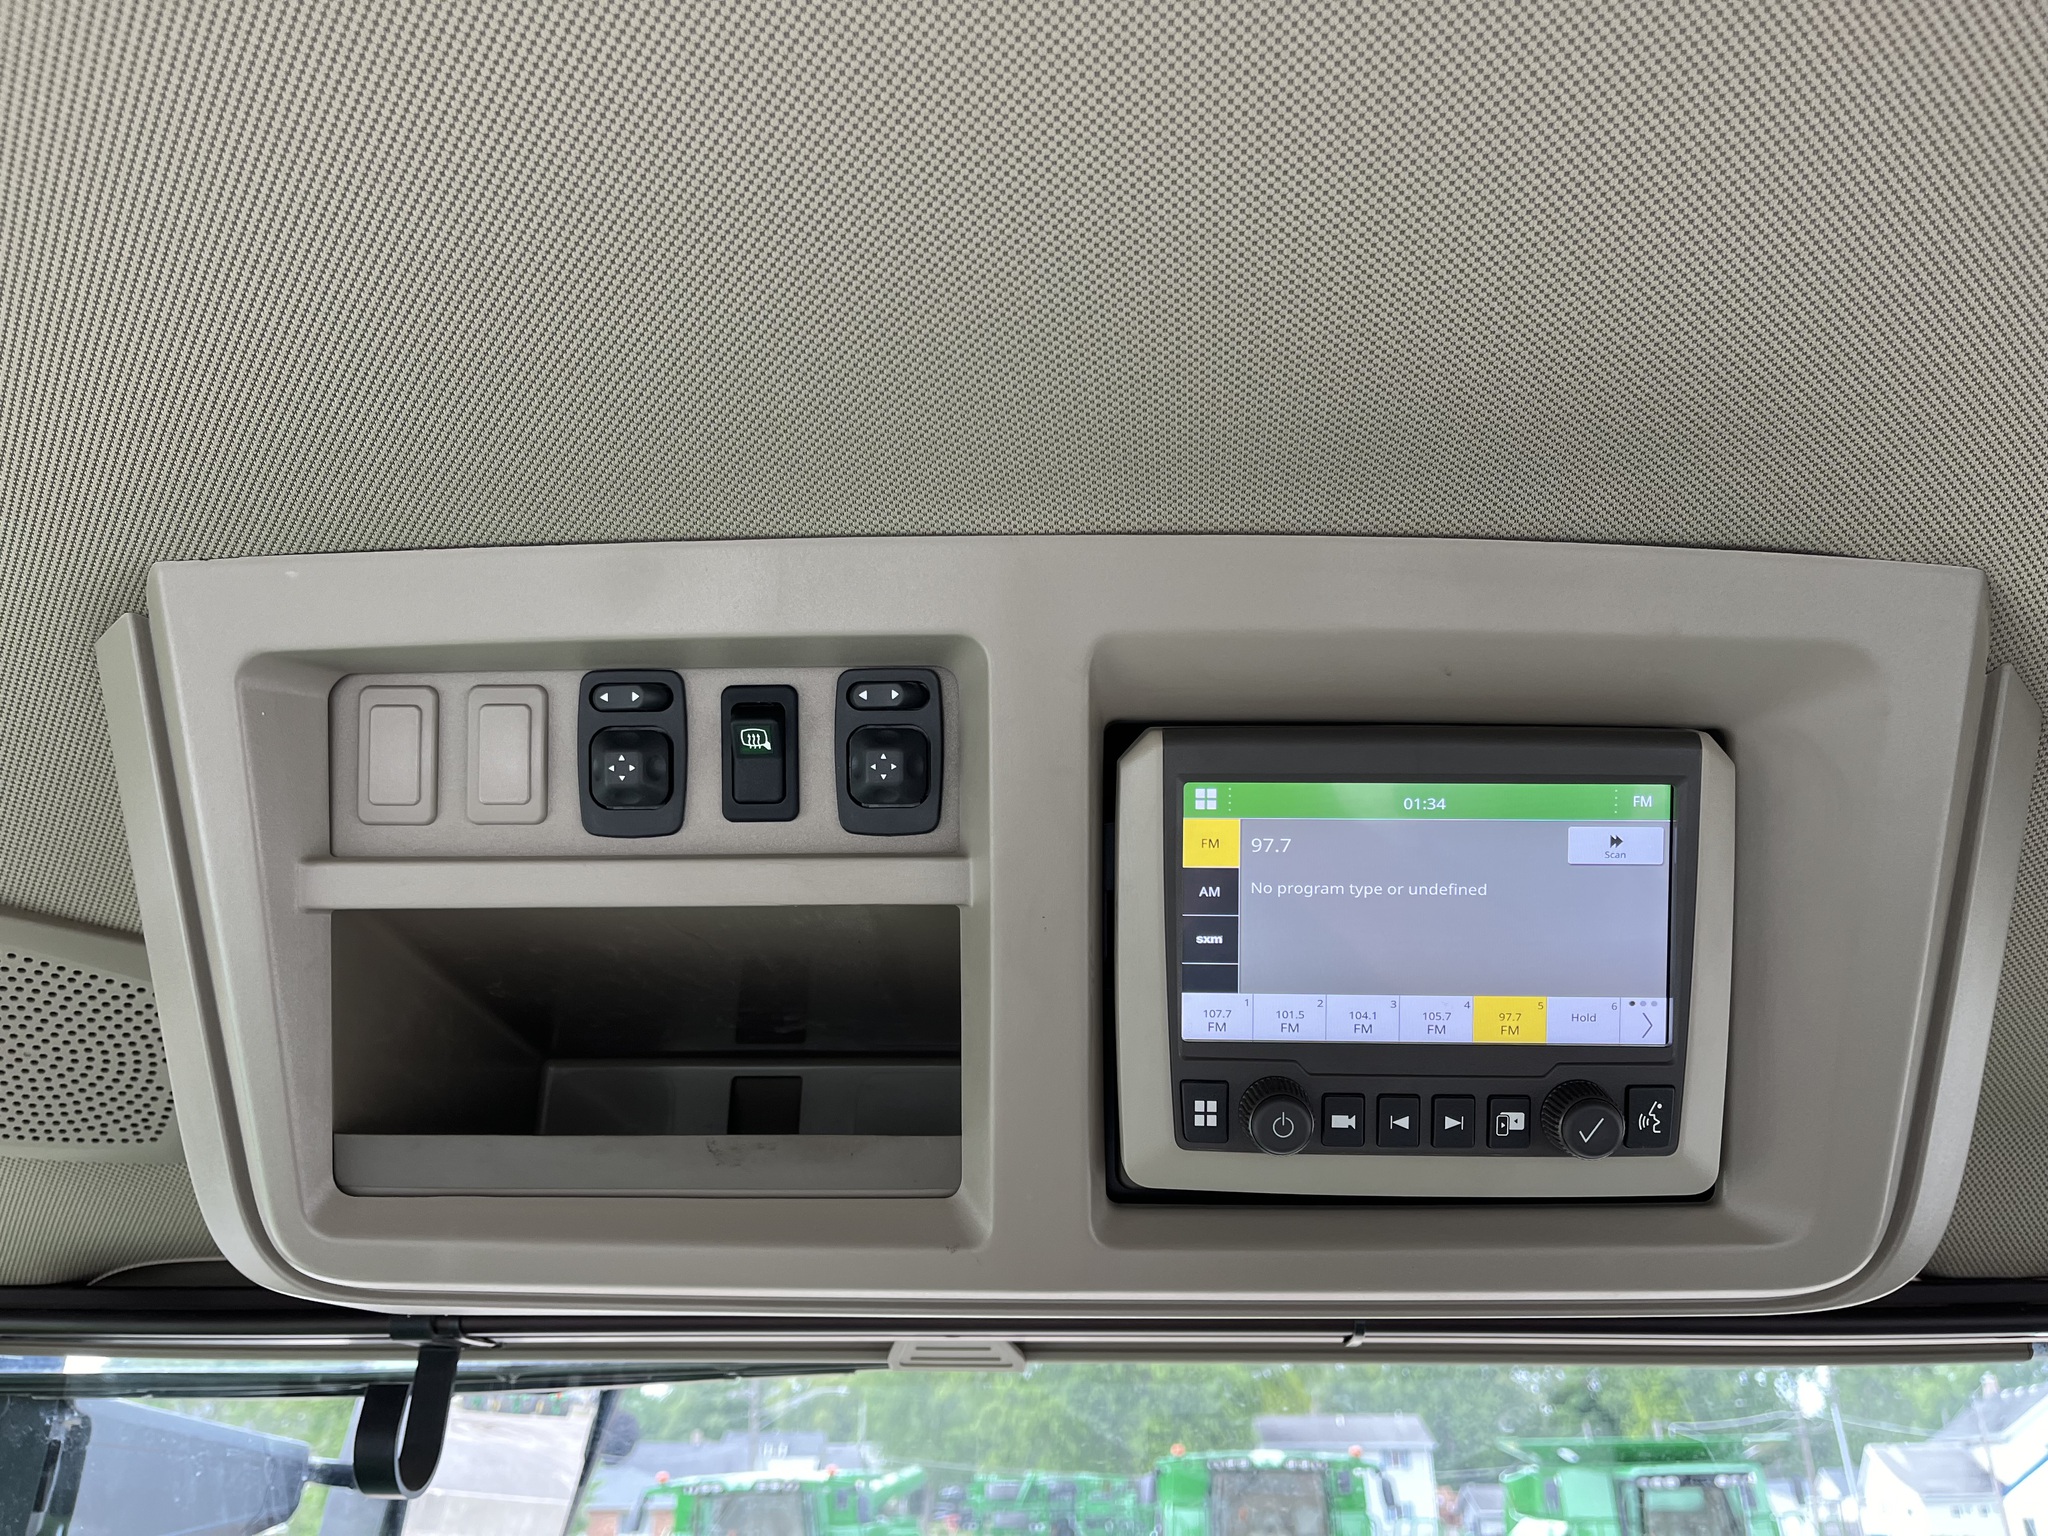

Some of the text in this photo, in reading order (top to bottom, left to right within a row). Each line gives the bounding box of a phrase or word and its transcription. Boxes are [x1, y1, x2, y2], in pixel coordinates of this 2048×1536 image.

[1403, 797, 1447, 811] 01:34
[1633, 795, 1652, 807] FM
[1201, 838, 1220, 849] FM
[1251, 837, 1292, 853] 97.7
[1604, 850, 1627, 859] Scan
[1198, 886, 1221, 898] AM
[1251, 881, 1487, 899] No program type or undefined
[1195, 935, 1223, 944] sxm
[1244, 998, 1249, 1007] 1
[1316, 999, 1324, 1008] 2
[1390, 1000, 1397, 1009] 3
[1463, 1000, 1471, 1009] 4
[1537, 1001, 1544, 1010] 5
[1611, 1002, 1618, 1011] 6
[1203, 1009, 1232, 1019] 107.7
[1275, 1010, 1305, 1020] 101.5
[1349, 1010, 1377, 1020] 104.1
[1422, 1011, 1452, 1021] 105.7
[1498, 1012, 1522, 1022] 97.7
[1571, 1012, 1597, 1023] Hold
[1207, 1021, 1227, 1032] FM
[1280, 1022, 1300, 1033] FM
[1353, 1023, 1373, 1034] FM
[1427, 1024, 1446, 1035] FM
[1500, 1025, 1520, 1036] FM
